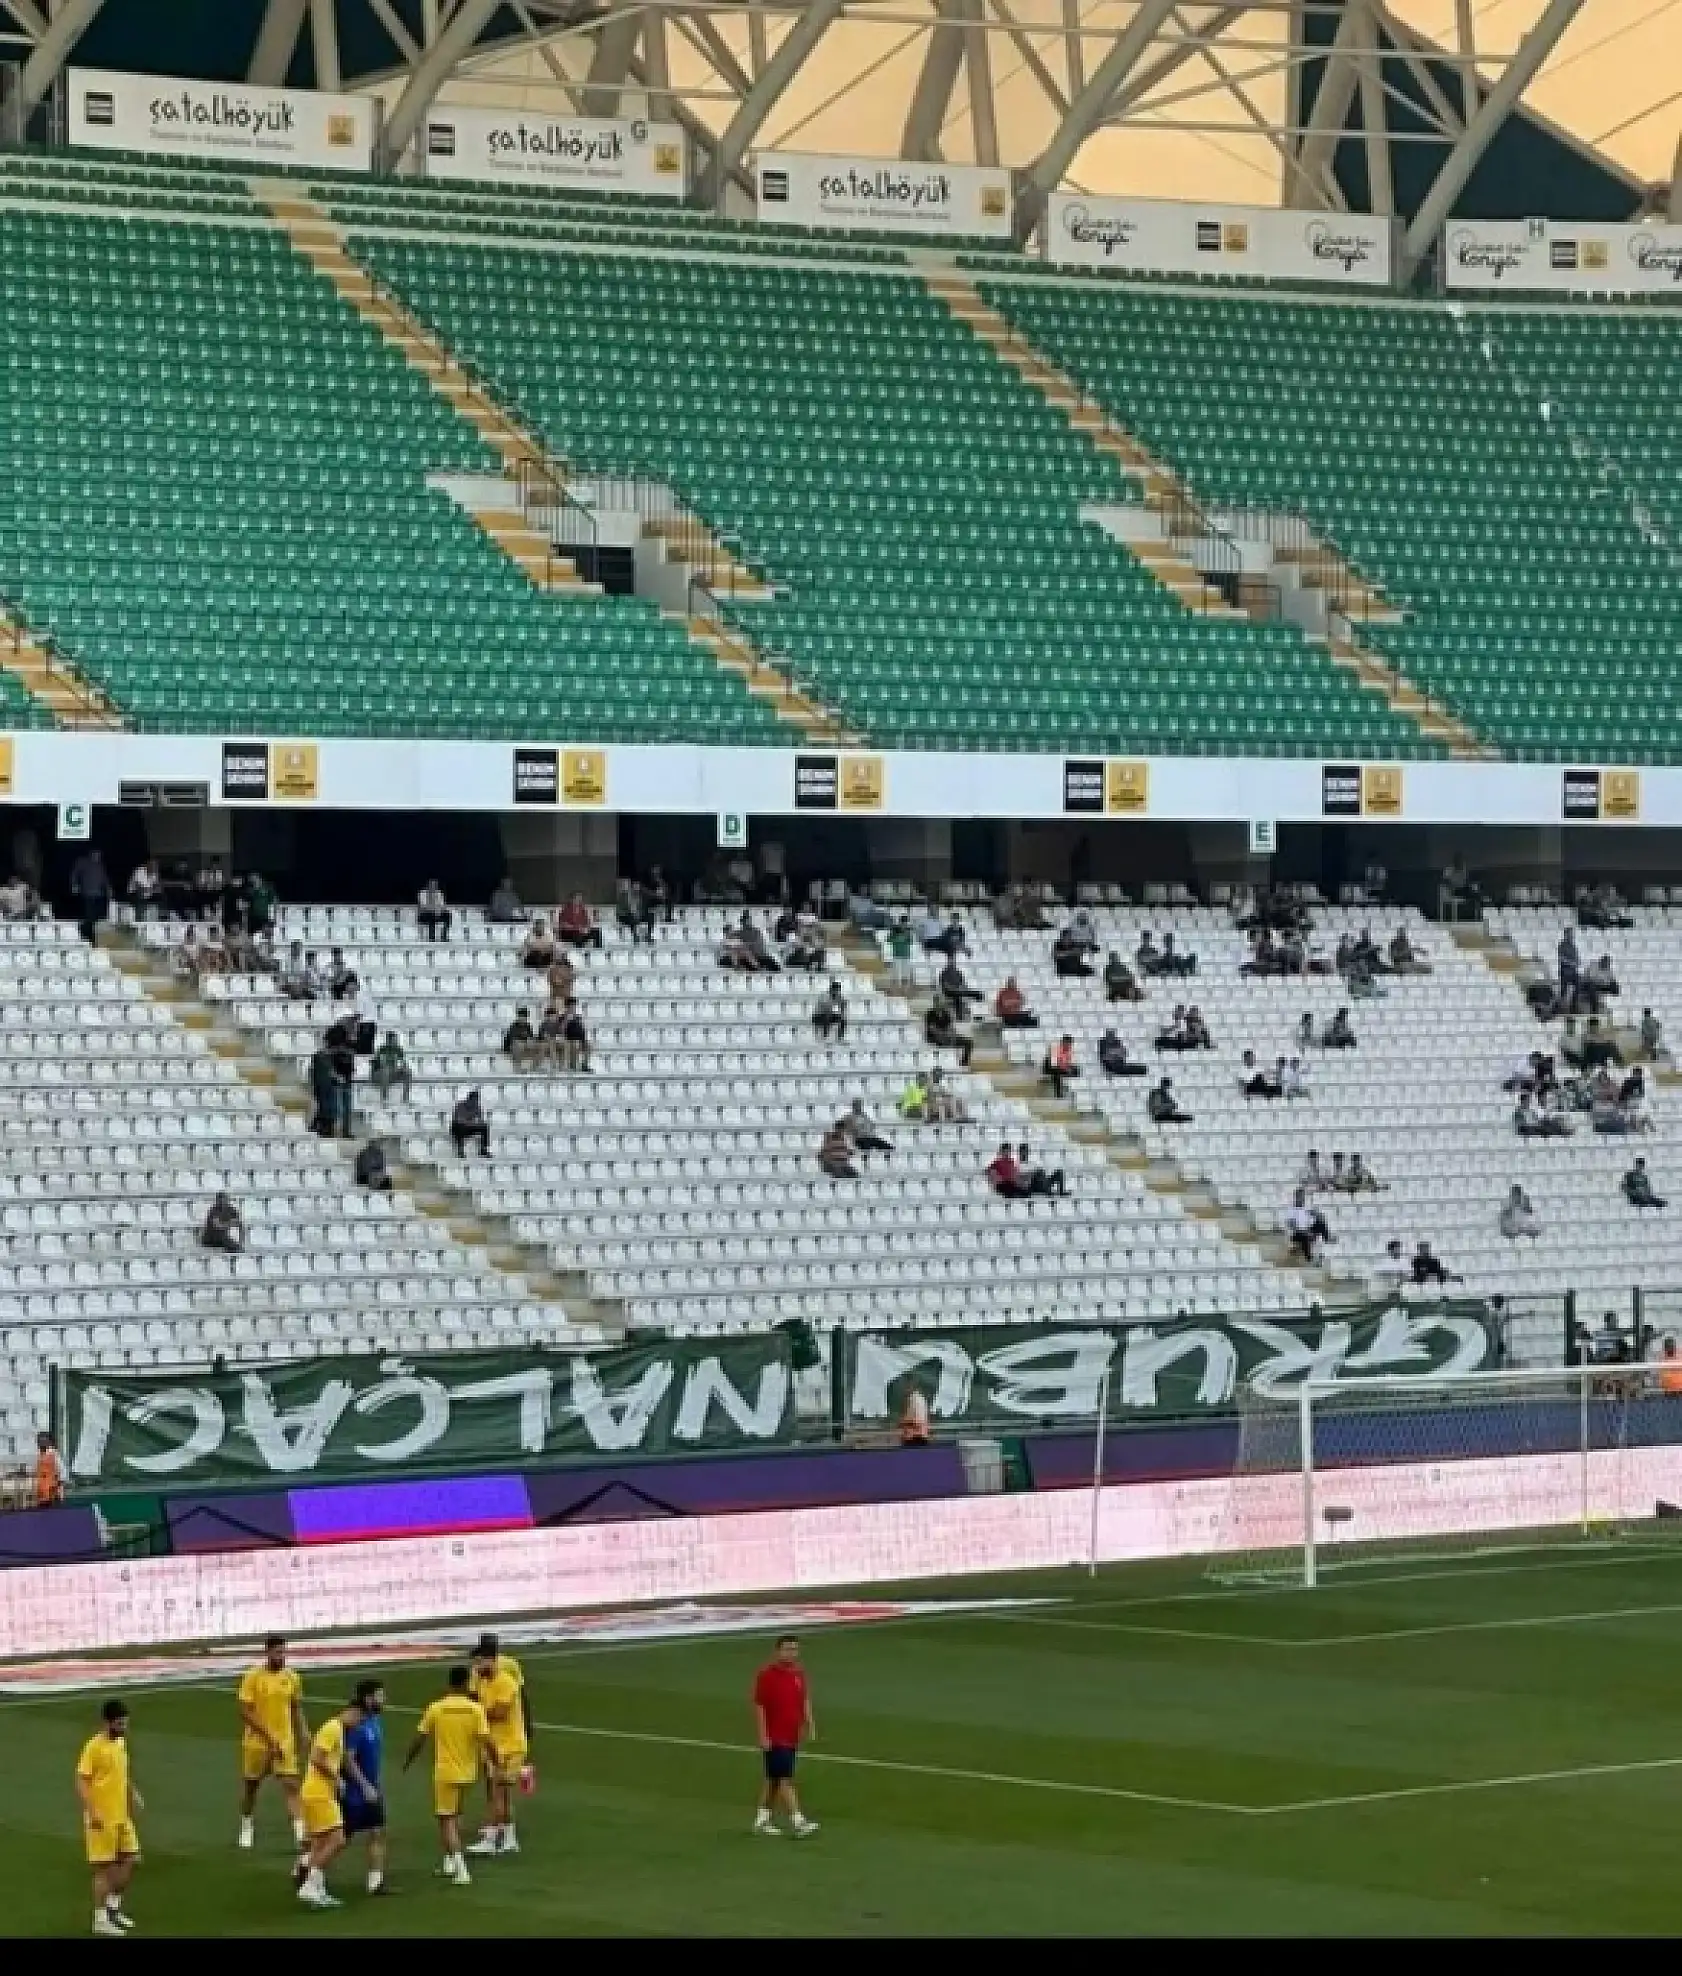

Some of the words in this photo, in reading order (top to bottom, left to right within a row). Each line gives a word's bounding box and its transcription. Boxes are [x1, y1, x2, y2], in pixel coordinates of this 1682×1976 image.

[631, 119, 647, 142] G
[65, 804, 84, 828] C
[725, 812, 741, 836] D
[1255, 820, 1271, 842] E
[851, 1306, 1487, 1418] GRUBU
[70, 1356, 791, 1476] NALÇACI
